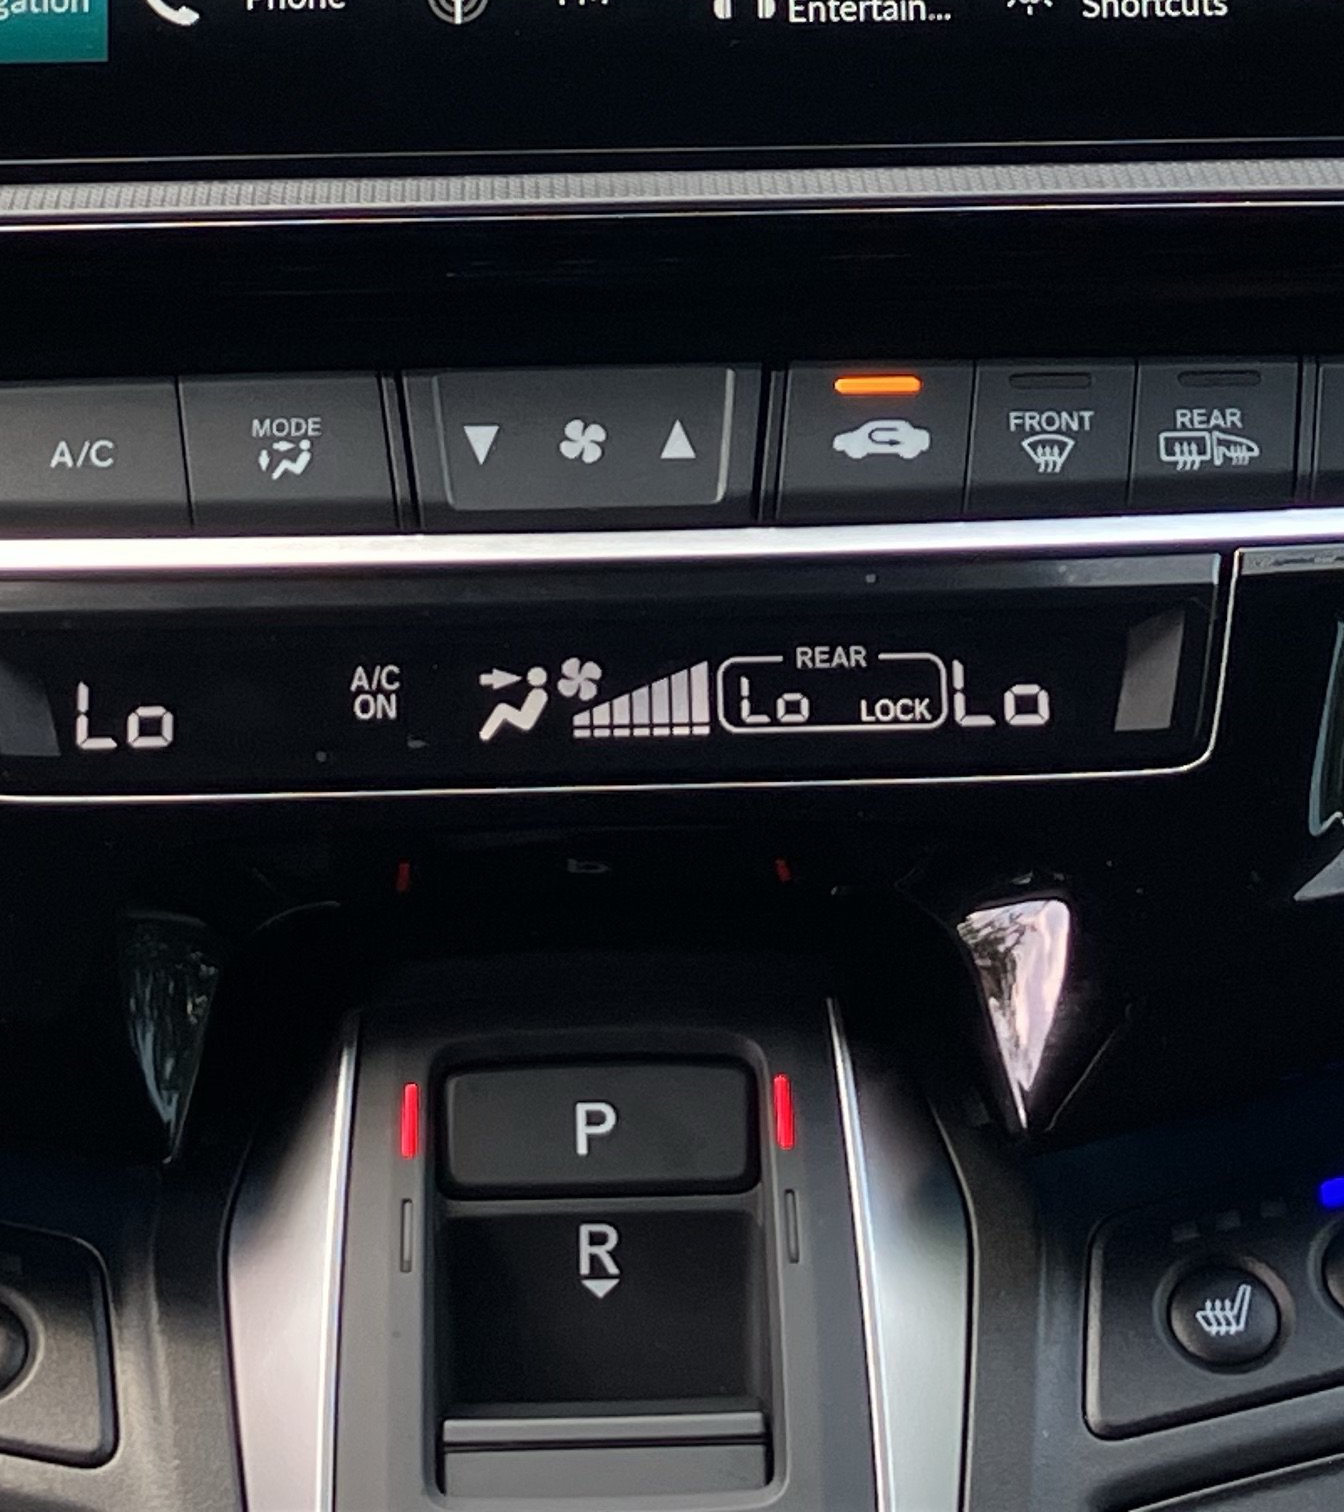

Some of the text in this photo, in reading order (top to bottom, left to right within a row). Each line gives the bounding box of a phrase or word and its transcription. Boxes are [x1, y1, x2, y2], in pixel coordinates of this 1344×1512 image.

[251, 417, 322, 438] MODE
[1009, 410, 1095, 433] FRONT
[1175, 407, 1243, 429] REAR
[49, 439, 114, 469] A/C
[795, 645, 867, 669] REAR
[349, 664, 400, 692] A/C
[353, 693, 397, 720] ON
[860, 697, 932, 722] LOCK
[575, 1102, 616, 1156] P
[579, 1223, 620, 1276] R
